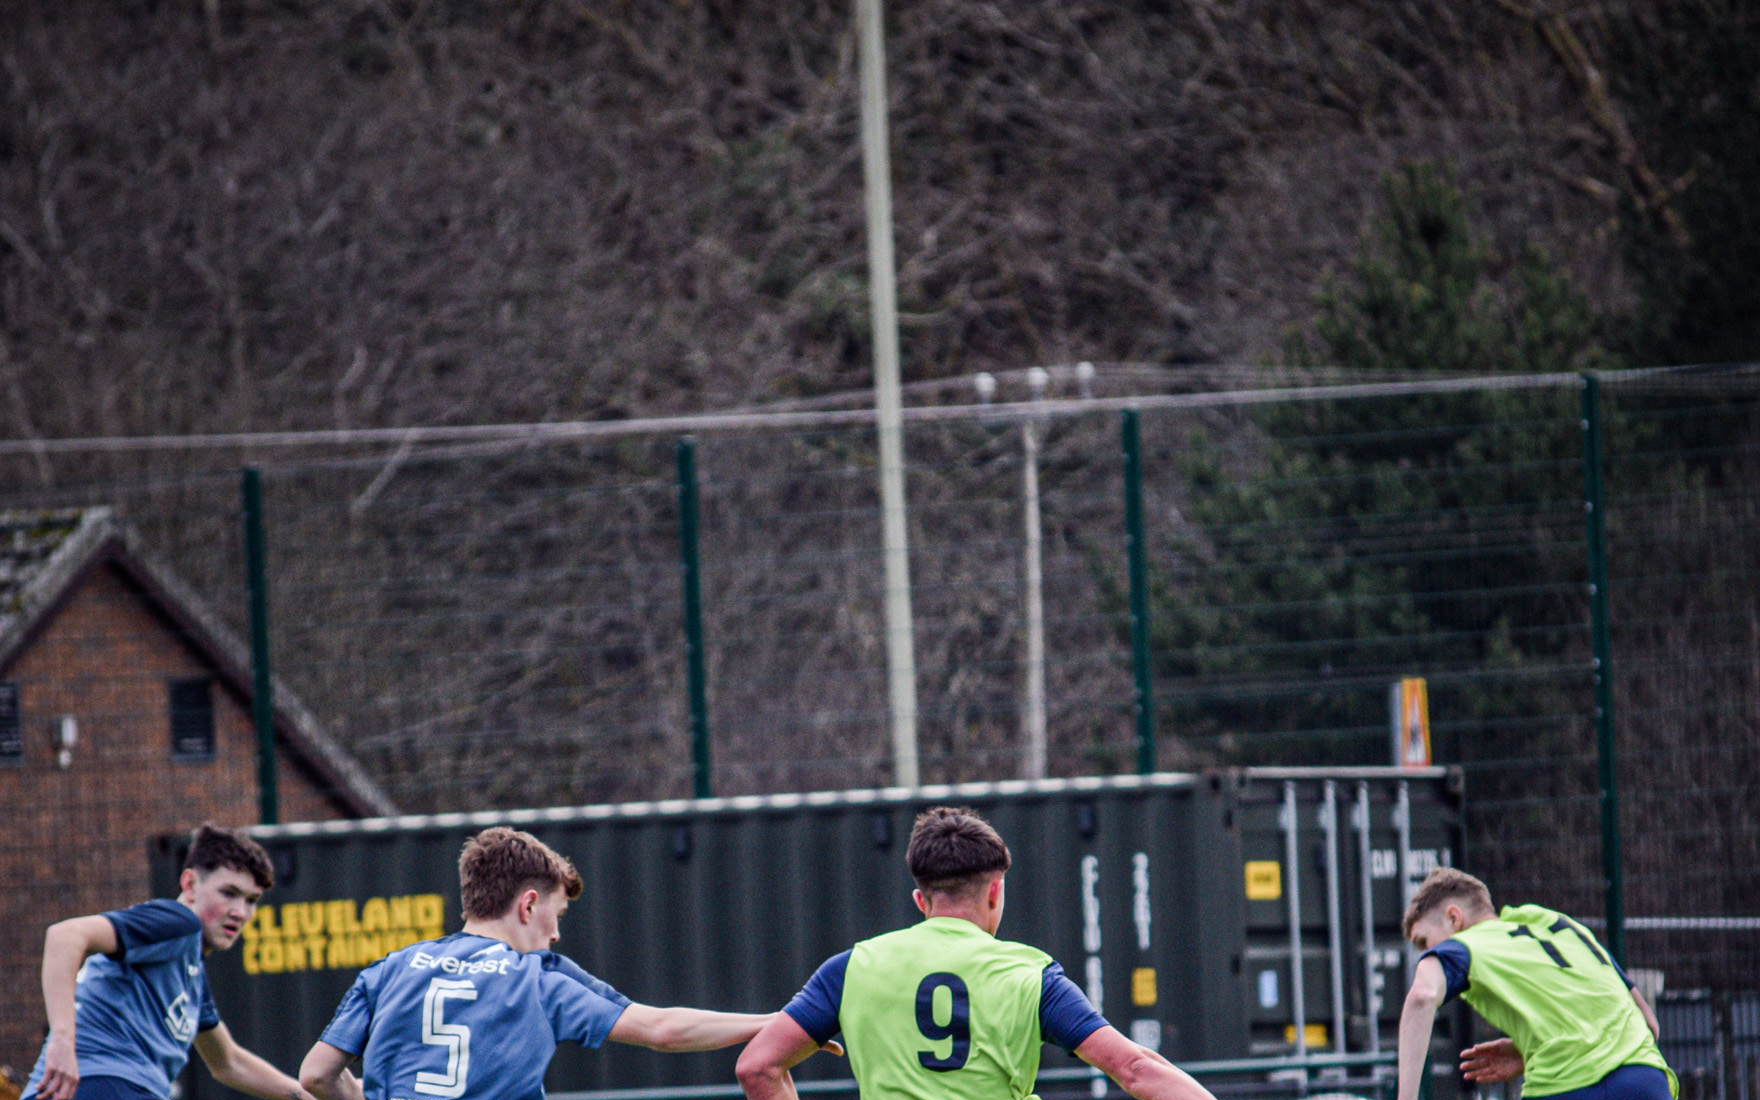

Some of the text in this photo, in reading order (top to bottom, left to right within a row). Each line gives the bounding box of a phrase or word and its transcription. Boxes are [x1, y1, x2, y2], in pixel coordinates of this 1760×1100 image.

[242, 893, 444, 940] CLEVELAND
[410, 952, 511, 975] Everest
[414, 977, 478, 1098] 5
[914, 971, 971, 1073] 9
